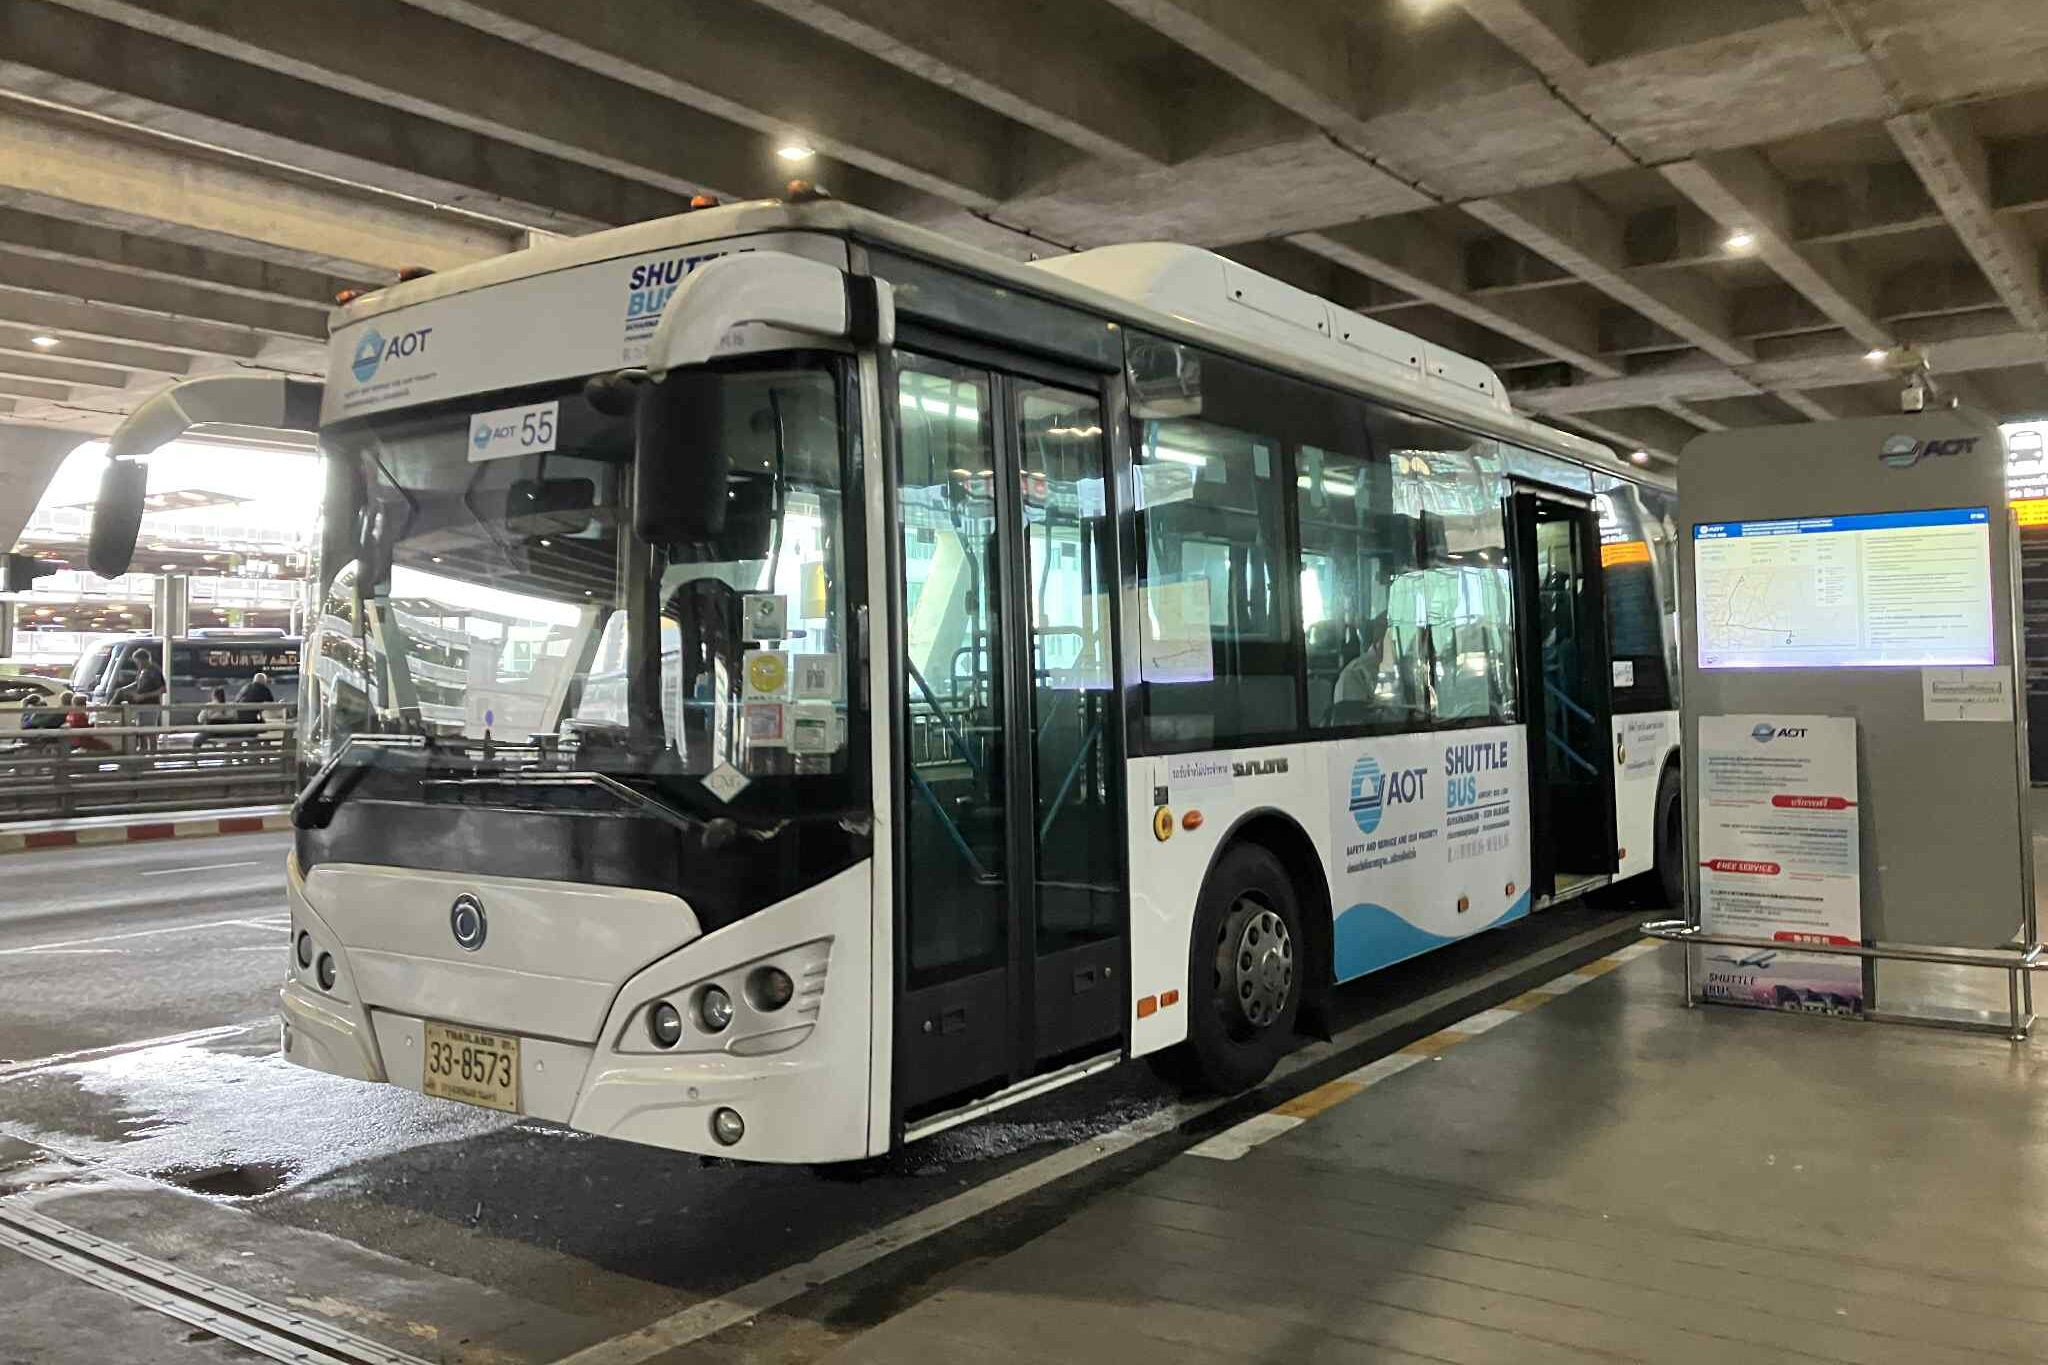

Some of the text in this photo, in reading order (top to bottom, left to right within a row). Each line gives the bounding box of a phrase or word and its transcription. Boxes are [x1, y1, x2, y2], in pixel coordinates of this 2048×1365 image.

[629, 250, 740, 290] SHUT
[385, 328, 433, 362] AOT
[491, 410, 554, 447] AOT 55
[1922, 438, 1980, 457] AOT
[1777, 728, 1808, 738] AOT
[1445, 741, 1508, 776] SHUTTLE
[1387, 768, 1428, 805] AOT
[1447, 776, 1476, 808] BUS
[1716, 861, 1775, 873] FREE SERVICE
[445, 1029, 495, 1047] THAILAND
[430, 1041, 511, 1088] 33-8573
